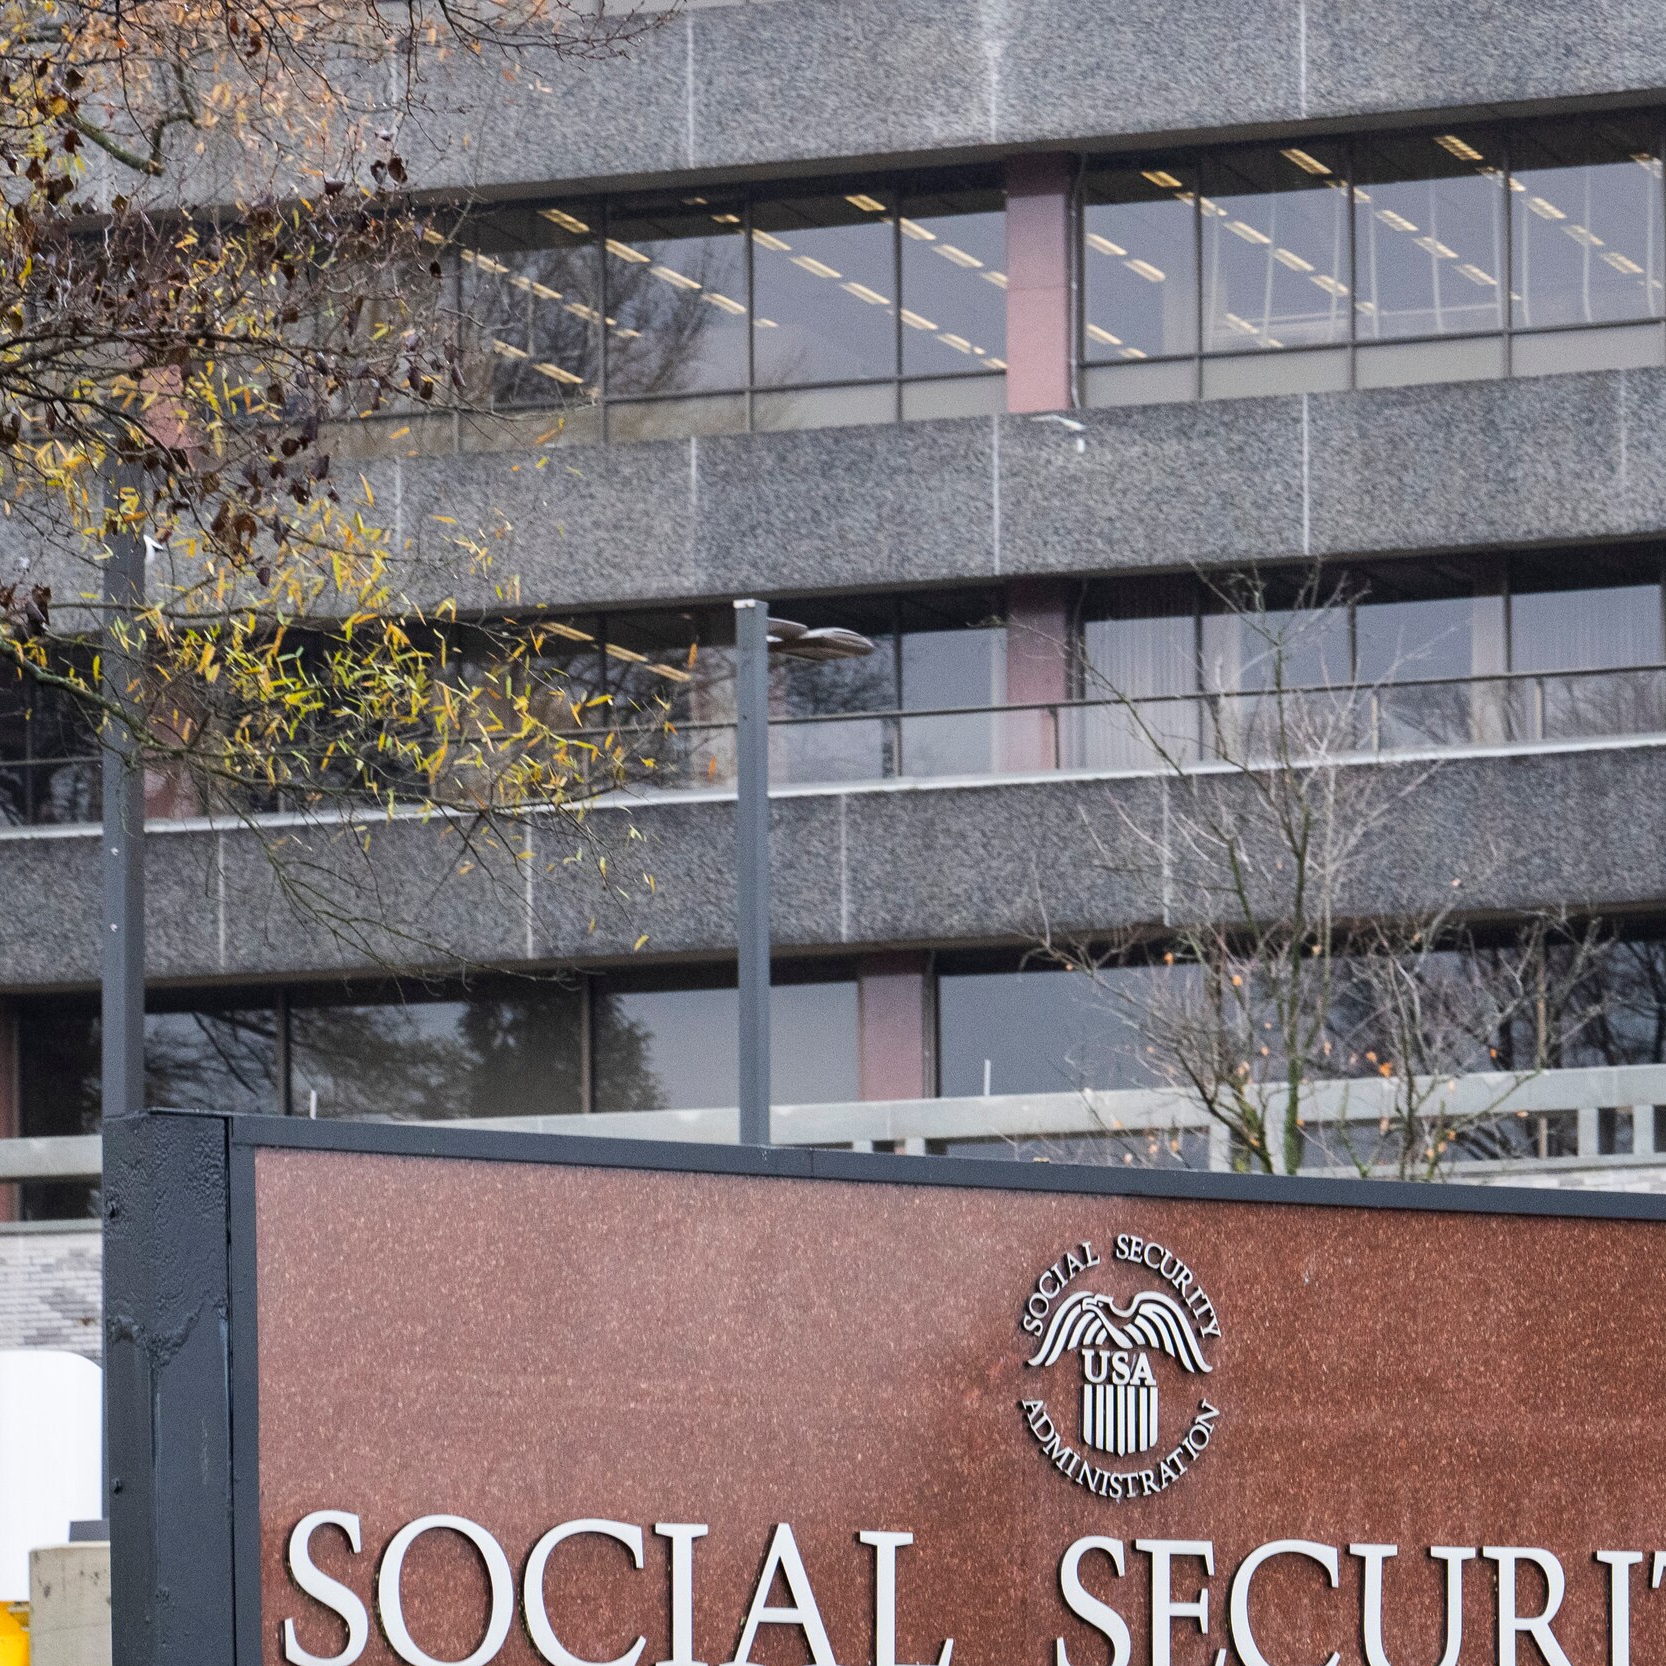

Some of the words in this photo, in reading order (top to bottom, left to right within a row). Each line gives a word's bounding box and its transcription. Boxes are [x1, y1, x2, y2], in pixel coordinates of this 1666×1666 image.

[1022, 1240, 1101, 1337] SOCIAL
[1116, 1233, 1222, 1338] SECURITY
[1082, 1349, 1157, 1386] USA
[1021, 1397, 1221, 1499] ADMINISTRATION
